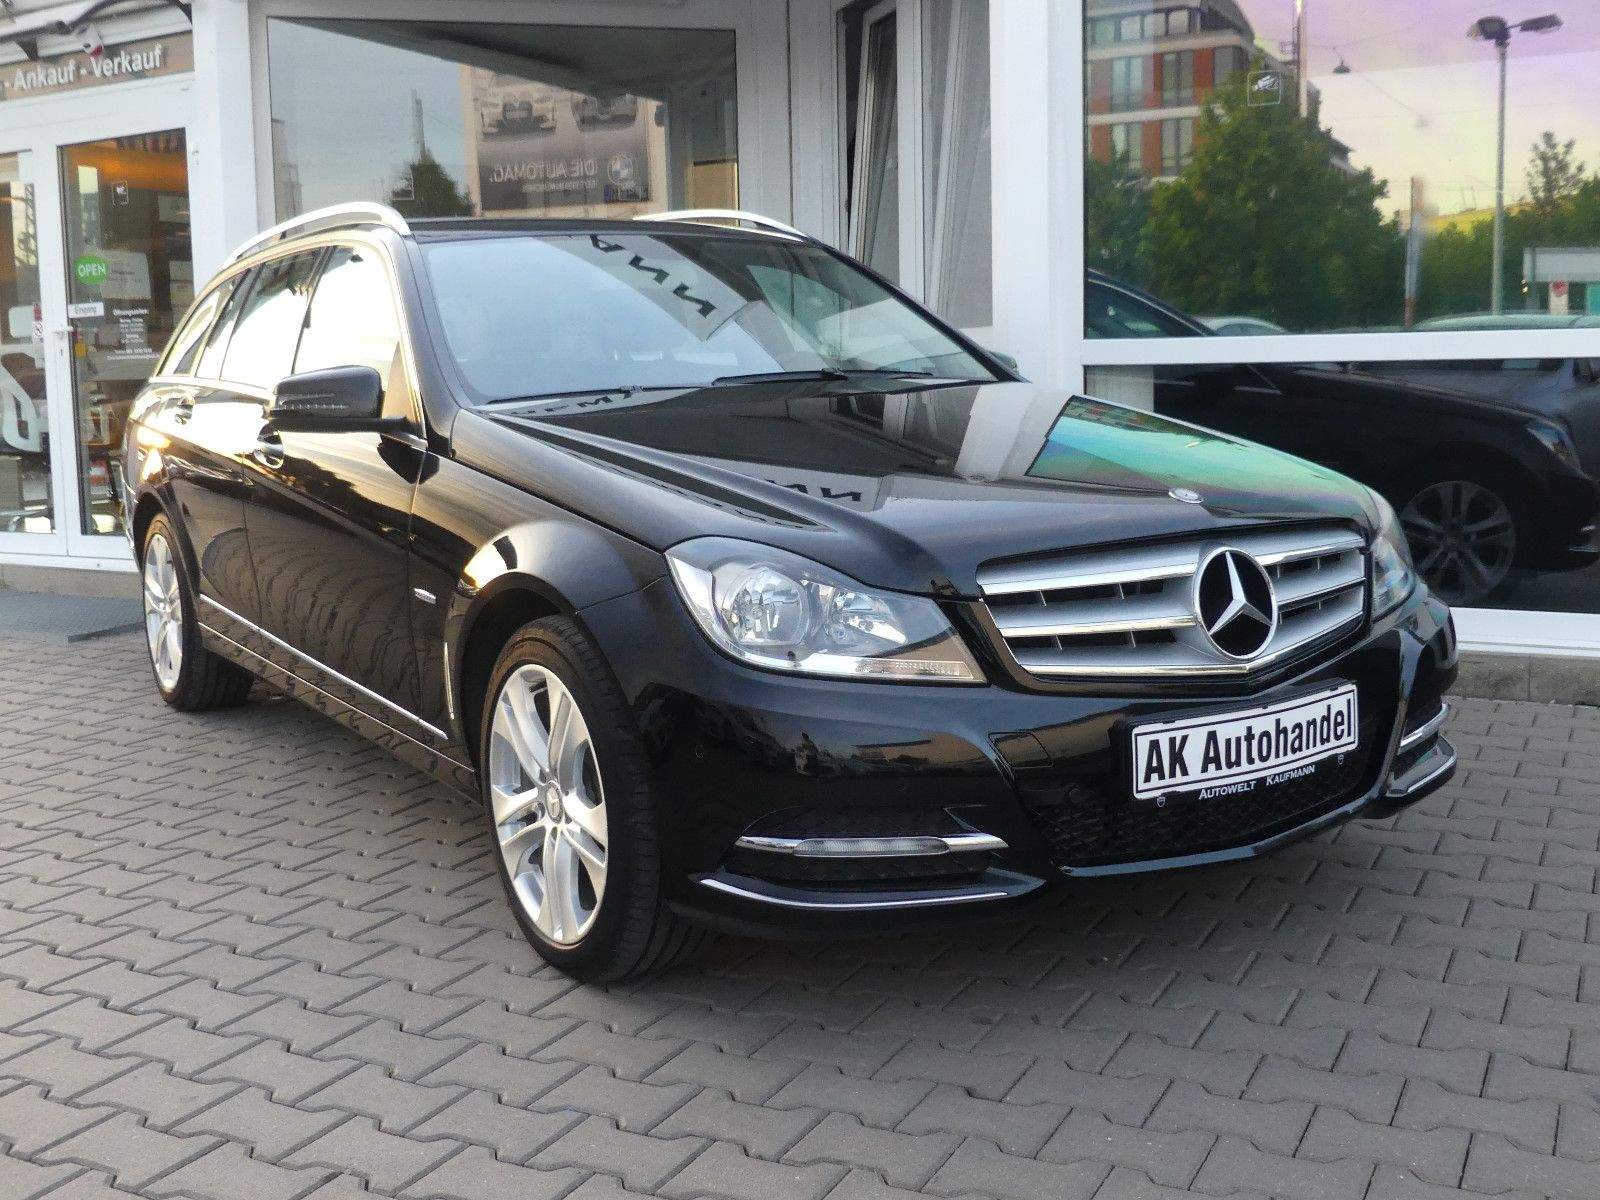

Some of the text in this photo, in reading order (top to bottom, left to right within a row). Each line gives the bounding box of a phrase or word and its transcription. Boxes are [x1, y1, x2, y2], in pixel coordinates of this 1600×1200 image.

[13, 43, 163, 90] Ankauf Verkauf
[78, 263, 106, 277] OPEN
[1143, 698, 1352, 784] AK Autohandel
[1198, 765, 1316, 800] AUTOWELT KAUFMANN
